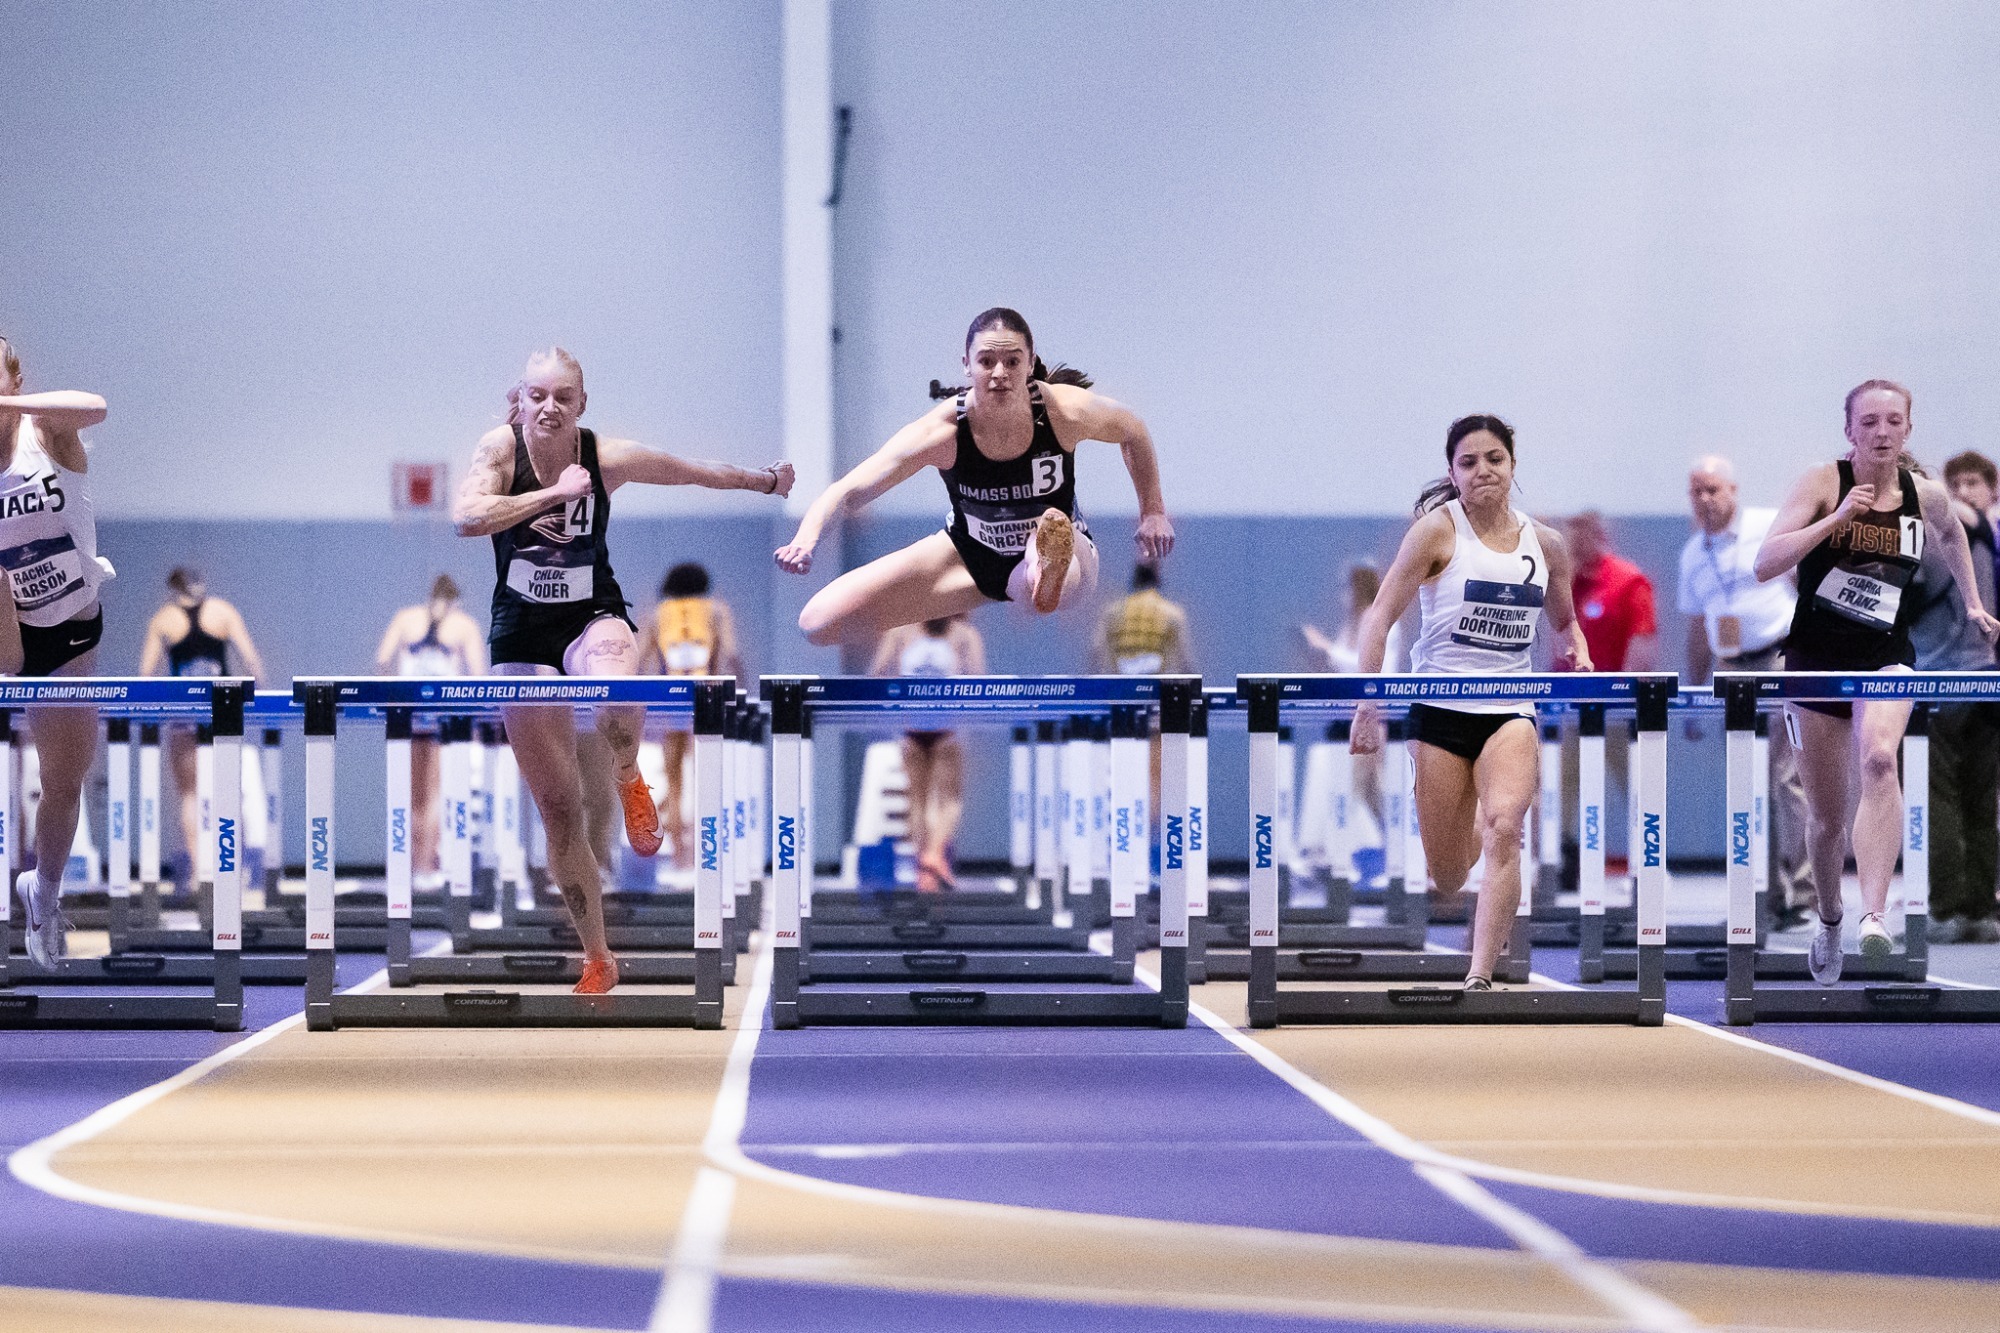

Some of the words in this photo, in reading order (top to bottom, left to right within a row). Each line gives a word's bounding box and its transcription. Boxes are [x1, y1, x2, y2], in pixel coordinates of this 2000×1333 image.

[42, 474, 65, 512] 5
[959, 483, 1009, 500] UMASS
[1039, 460, 1056, 494] 3
[570, 496, 588, 533] 4
[980, 520, 1038, 535] ARYIANNA
[1907, 521, 1916, 554] 1
[13, 561, 57, 586] RACHEL
[534, 570, 567, 581] CHLOE
[1522, 556, 1536, 584] 2
[1847, 577, 1882, 596] CIARRA
[528, 580, 570, 598] YODER
[1837, 587, 1880, 612] FRANZ
[1458, 616, 1530, 639] DORTMUND
[1472, 606, 1529, 621] KATHERINE
[5, 687, 34, 698] FIELD
[37, 686, 128, 698] CHAMPIONSHIPS
[441, 686, 476, 698] TRACK
[477, 686, 484, 698] &
[486, 686, 516, 698] FIELD
[518, 686, 610, 698] CHAMPIONSHIPS
[907, 684, 942, 696] TRACK
[944, 684, 951, 696] &
[953, 684, 982, 696] FIELD
[985, 684, 1076, 696] CHAMPIONSHIPS
[1384, 684, 1418, 694] TRACK
[1420, 684, 1428, 694] &
[1430, 684, 1458, 694] FIELD
[1462, 683, 1552, 694] CHAMPIONSHIPS
[1862, 682, 1896, 693] TRACK
[1897, 682, 1904, 692] &
[1907, 682, 1936, 692] FIELD
[219, 817, 235, 872] NCAA
[312, 817, 328, 872] NCAA
[393, 808, 406, 853] NCAA
[702, 816, 718, 871] NCAA
[779, 816, 795, 870] NCAA
[1117, 808, 1130, 853] NCAA
[1167, 815, 1183, 870] NCAA
[1188, 806, 1202, 851] NCAA
[1256, 814, 1272, 868] NCAA
[1586, 806, 1599, 850] NCAA
[1644, 812, 1660, 867] NCAA
[1733, 812, 1750, 867] NCAA
[1910, 806, 1923, 851] NCAA
